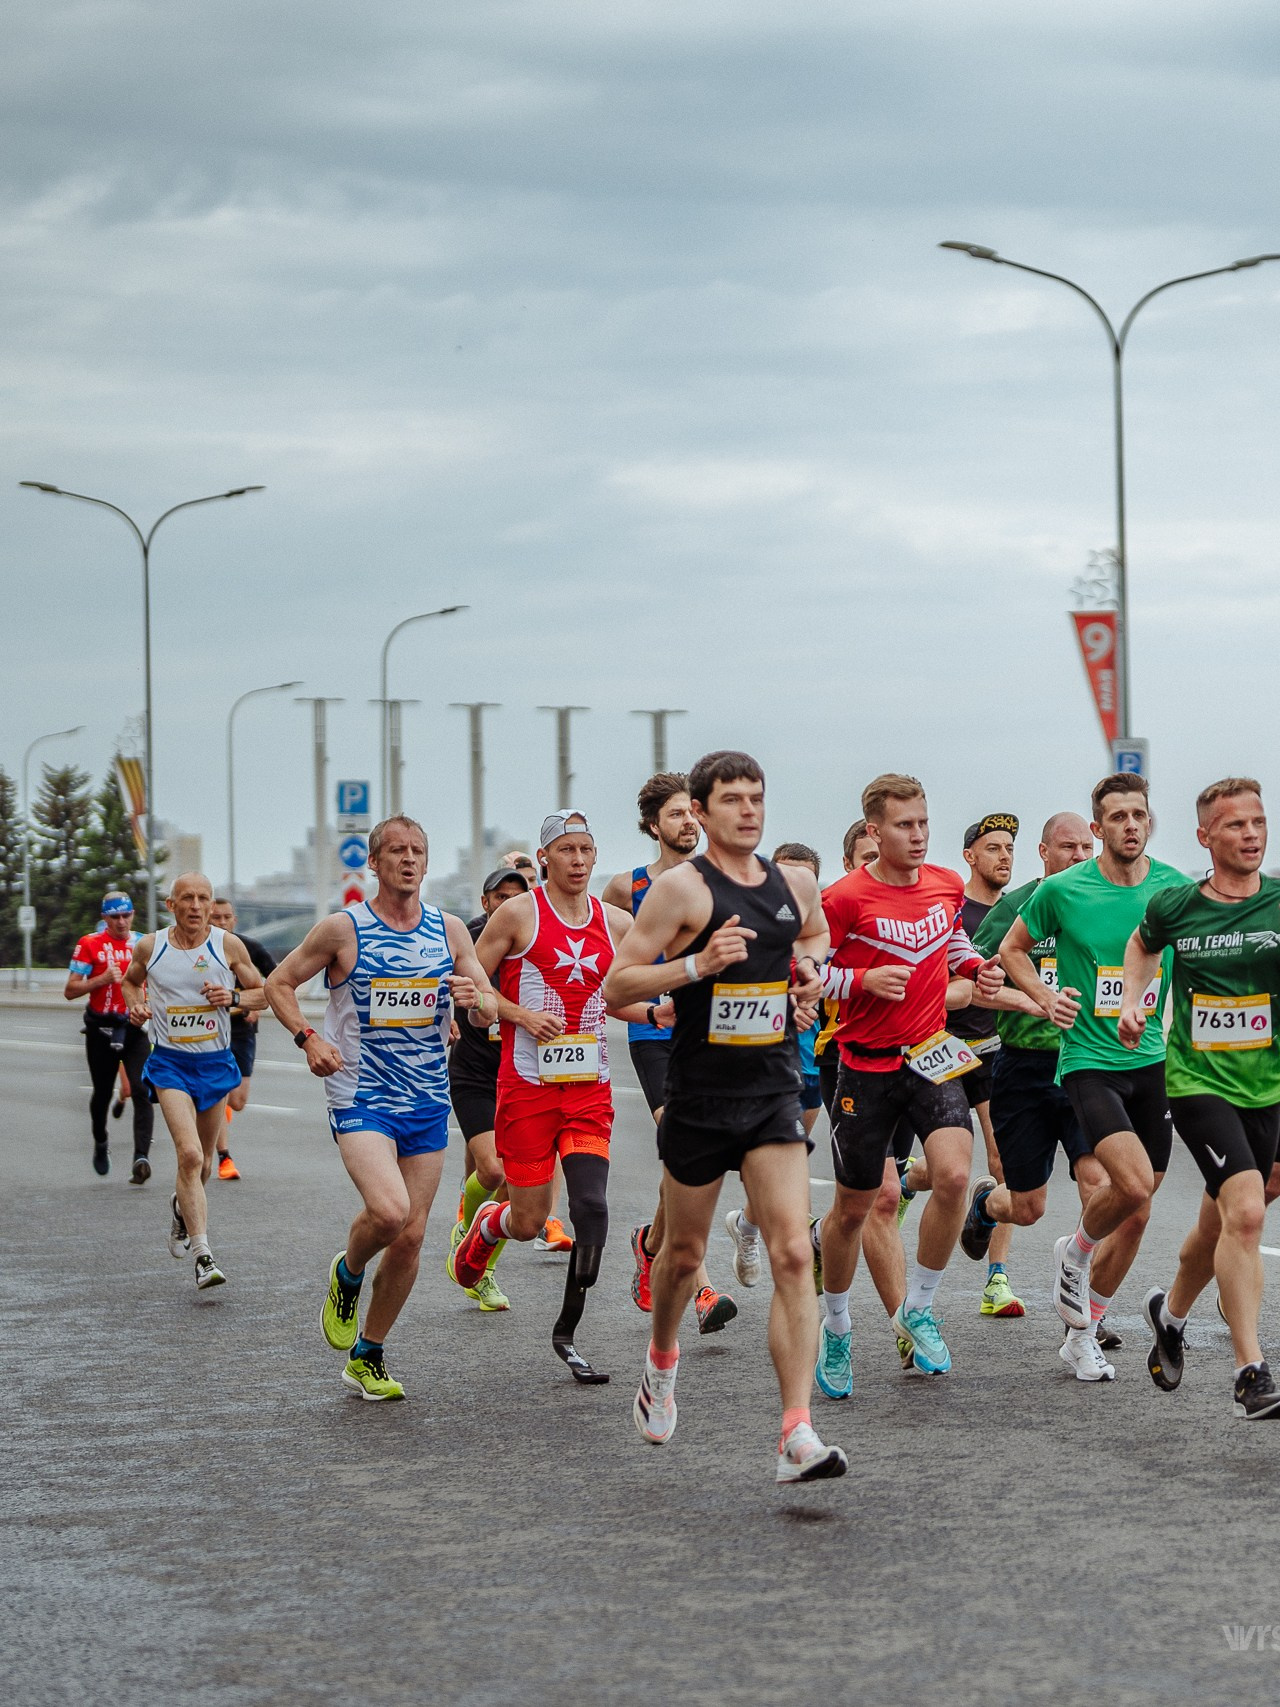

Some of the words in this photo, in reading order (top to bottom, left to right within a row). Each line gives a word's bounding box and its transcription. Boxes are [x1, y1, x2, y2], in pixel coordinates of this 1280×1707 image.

[1082, 621, 1113, 663] 9
[343, 783, 364, 811] P
[875, 907, 949, 949] RUSSIA
[1177, 937, 1201, 951] БЕГИ,
[1204, 931, 1244, 949] ГЕРОЙ!
[1198, 948, 1228, 958] НОВГОРОД
[1101, 980, 1123, 996] 30
[375, 991, 421, 1007] 7548
[718, 1000, 770, 1020] 3774
[1197, 1010, 1247, 1028] 7631
[170, 1014, 205, 1028] 6474
[543, 1046, 585, 1063] 6728
[916, 1043, 953, 1072] 4201
